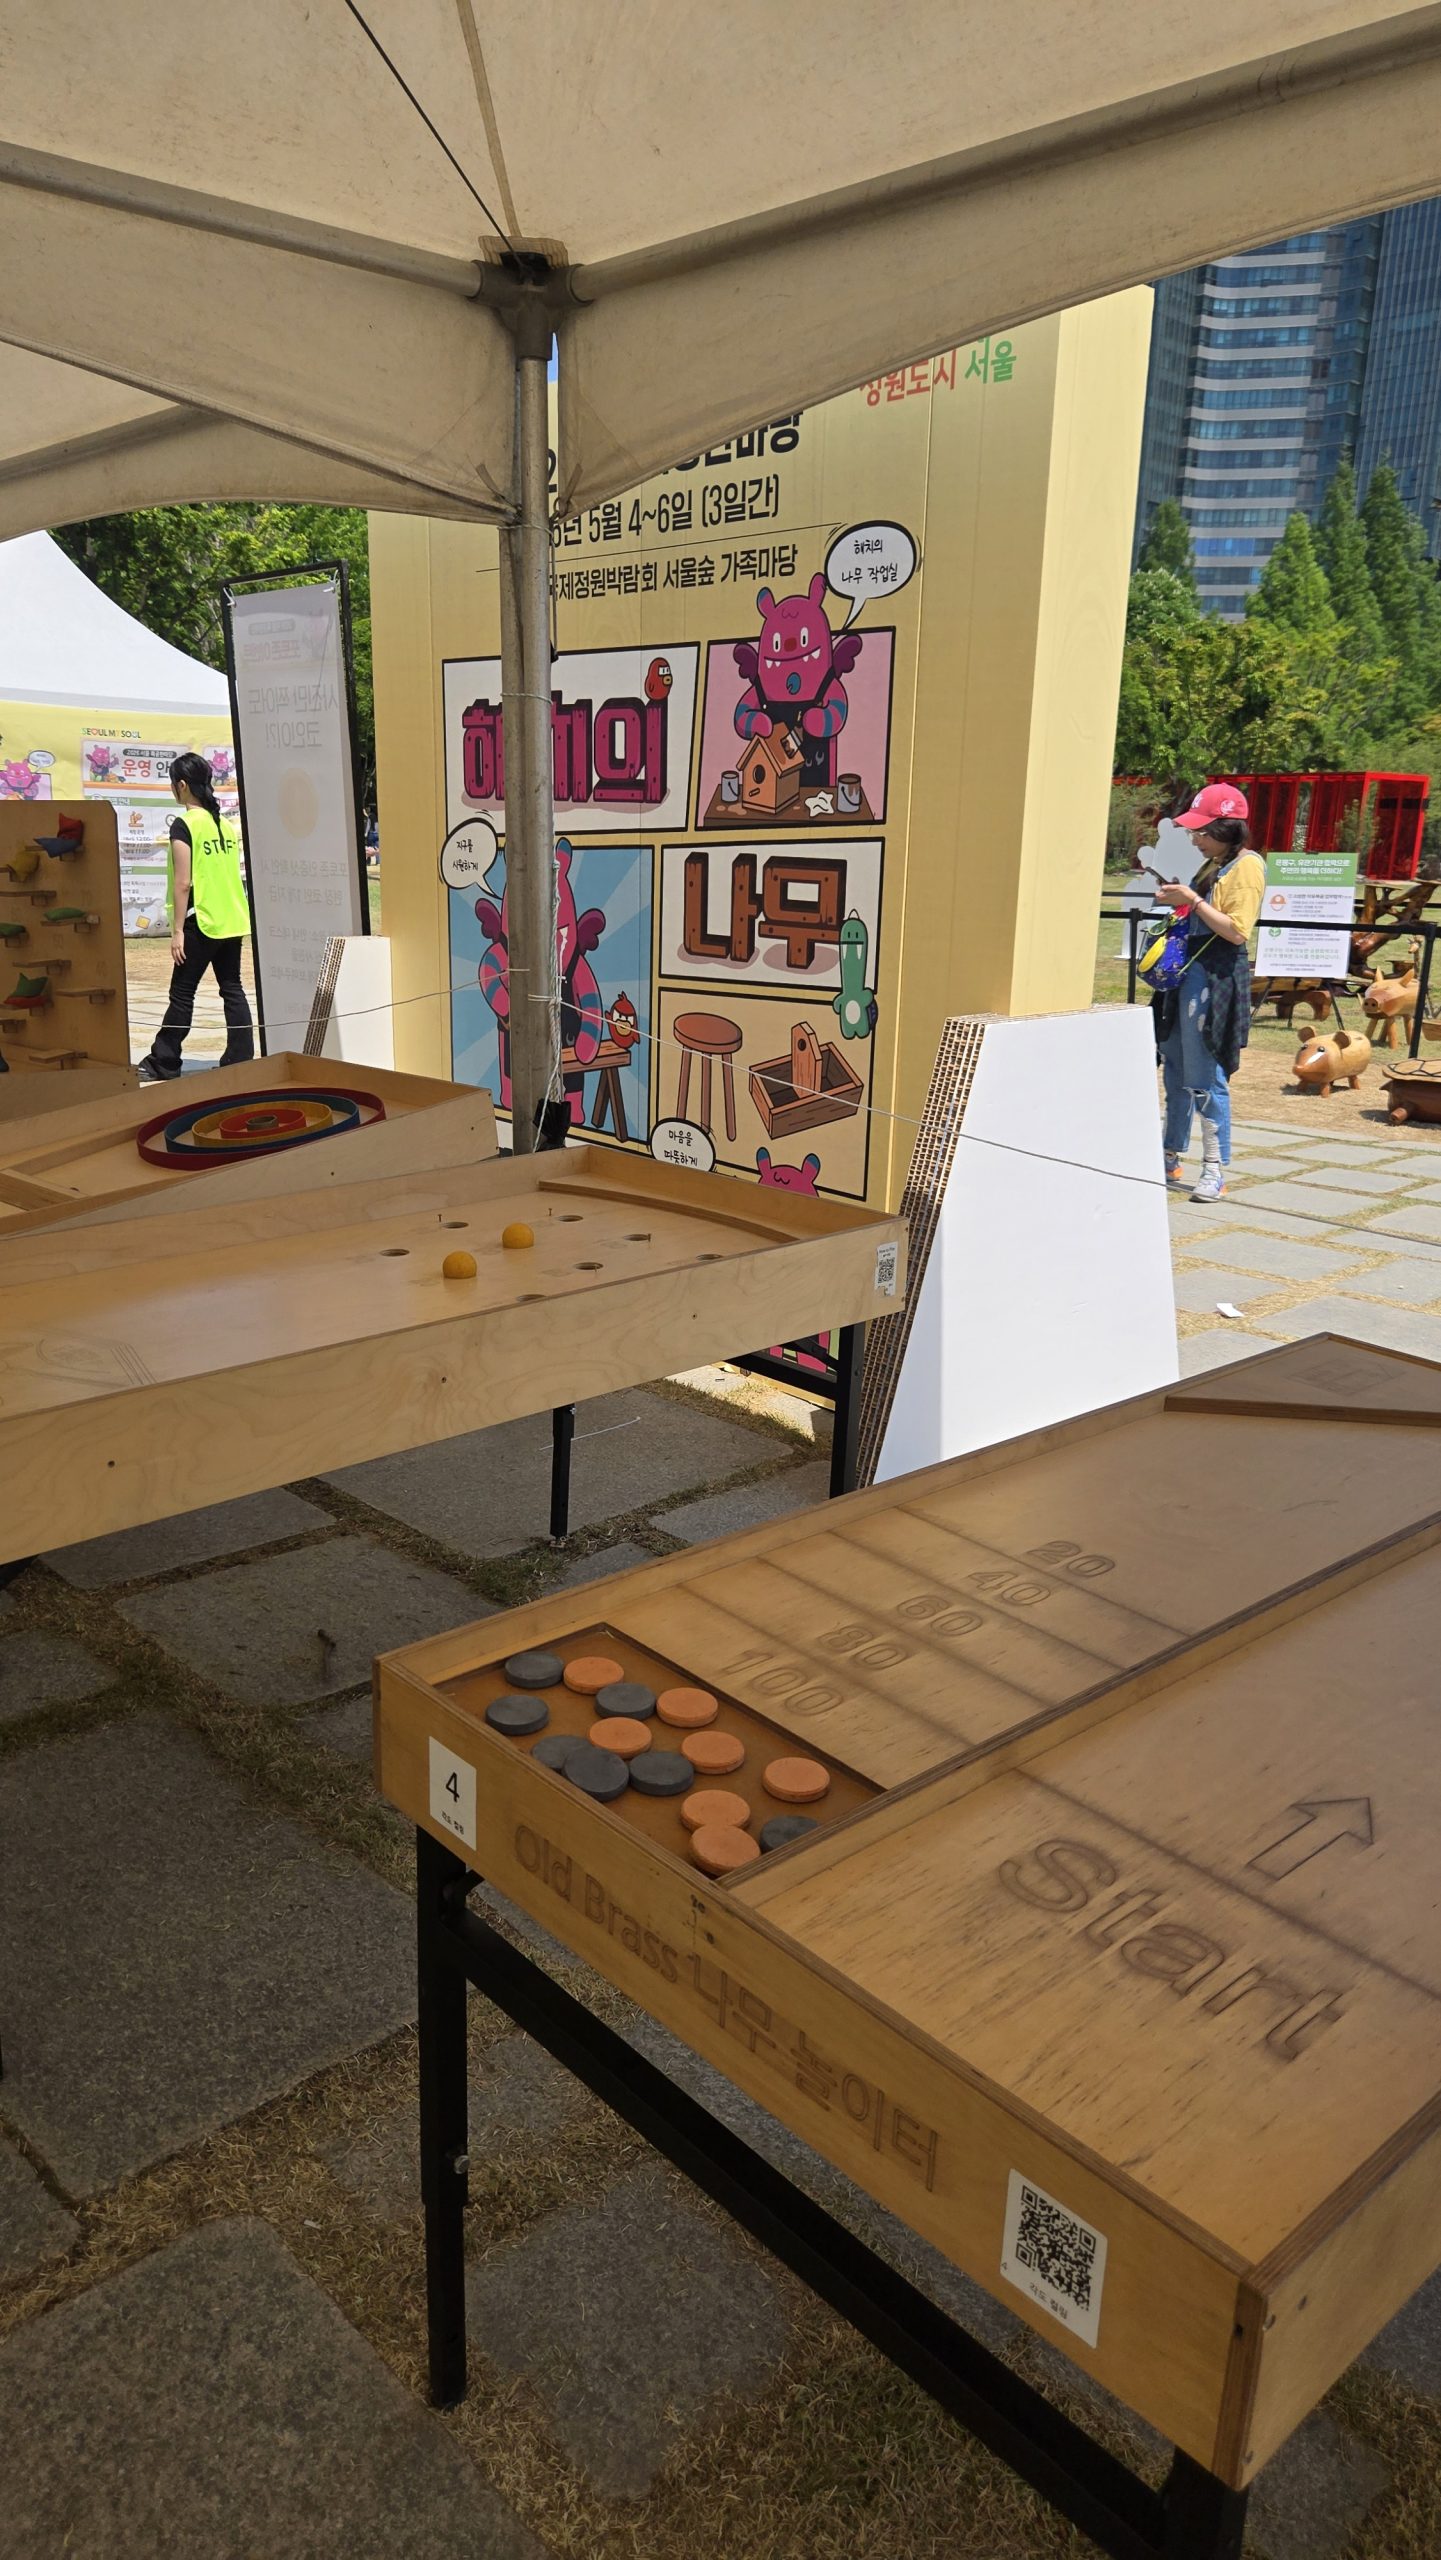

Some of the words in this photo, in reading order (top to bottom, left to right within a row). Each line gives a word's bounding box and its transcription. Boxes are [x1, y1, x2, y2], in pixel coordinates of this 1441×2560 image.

[964, 335, 1017, 384] 서울
[588, 501, 622, 543] 5월
[628, 490, 693, 537] 4~6일
[663, 555, 715, 589] 서울숲
[721, 543, 798, 583] 가족마당
[854, 539, 883, 554] 해치의
[842, 568, 863, 584] 나무
[868, 562, 898, 584] 작업실
[121, 759, 151, 777] 운영
[156, 761, 170, 778] 안
[684, 851, 848, 970] 나무
[664, 1150, 698, 1167] 따뜻하게
[668, 1130, 693, 1147] 마음을
[1026, 1540, 1116, 1578] 20
[968, 1570, 1051, 1606] 40
[897, 1595, 983, 1637] 60
[817, 1622, 909, 1670] 80
[720, 1650, 843, 1717] 100
[445, 1771, 460, 1803] 4
[514, 1825, 572, 1903] Old
[584, 1874, 679, 1984] Brass
[687, 1952, 777, 2053] 나무
[998, 1839, 1344, 2063] Start
